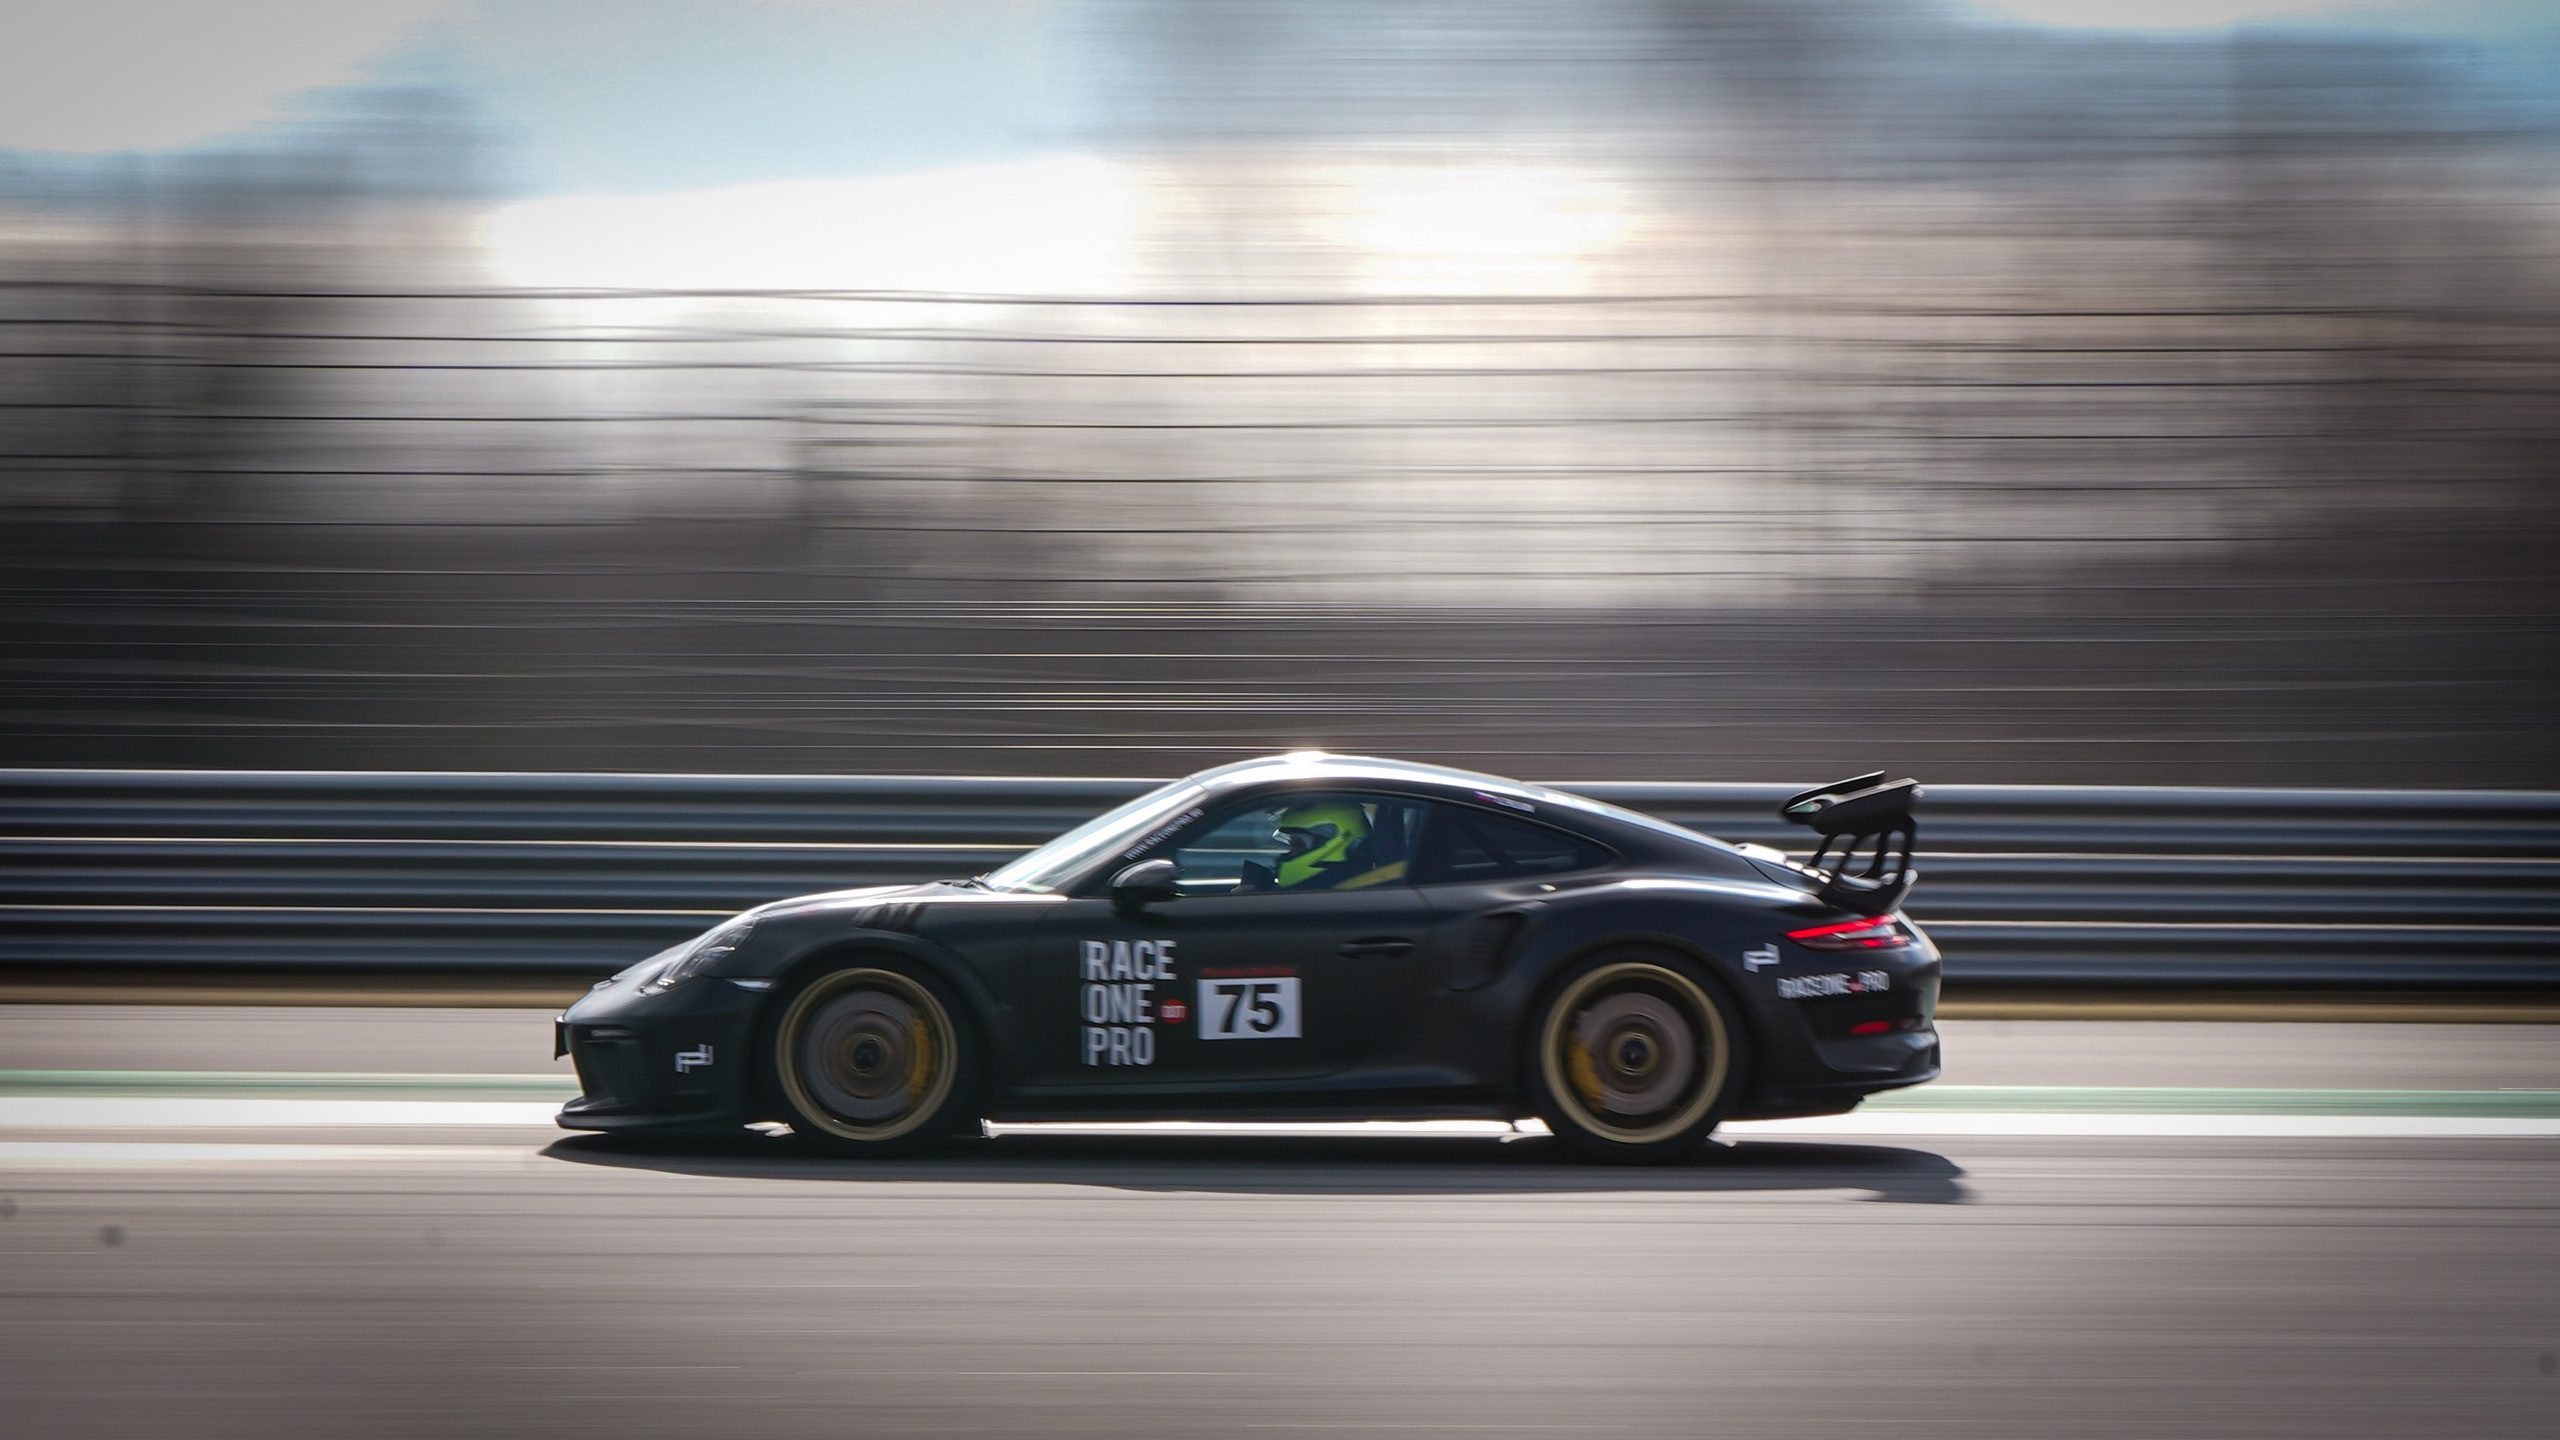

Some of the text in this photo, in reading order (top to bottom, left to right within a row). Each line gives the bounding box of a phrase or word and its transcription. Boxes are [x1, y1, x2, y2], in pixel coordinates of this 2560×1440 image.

[1080, 940, 1177, 981] RACE
[1080, 983, 1156, 1024] ONE
[1213, 983, 1281, 1033] 75
[1081, 1026, 1155, 1066] PRO
